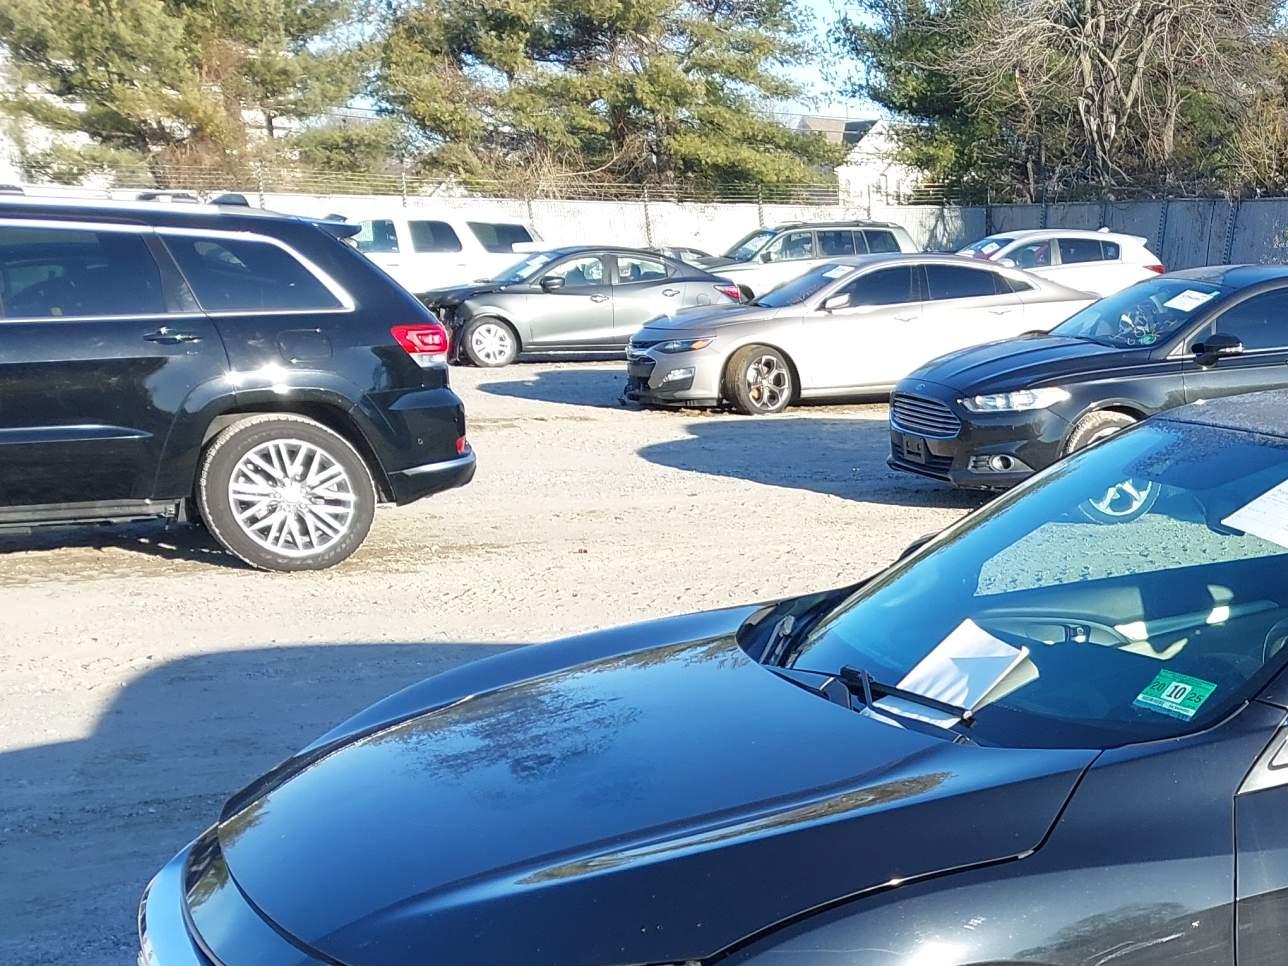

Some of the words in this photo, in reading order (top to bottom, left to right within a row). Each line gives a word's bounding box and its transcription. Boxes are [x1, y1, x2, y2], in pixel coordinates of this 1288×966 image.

[1152, 681, 1166, 691] 20
[1167, 684, 1187, 700] 10
[1187, 691, 1204, 704] 25
